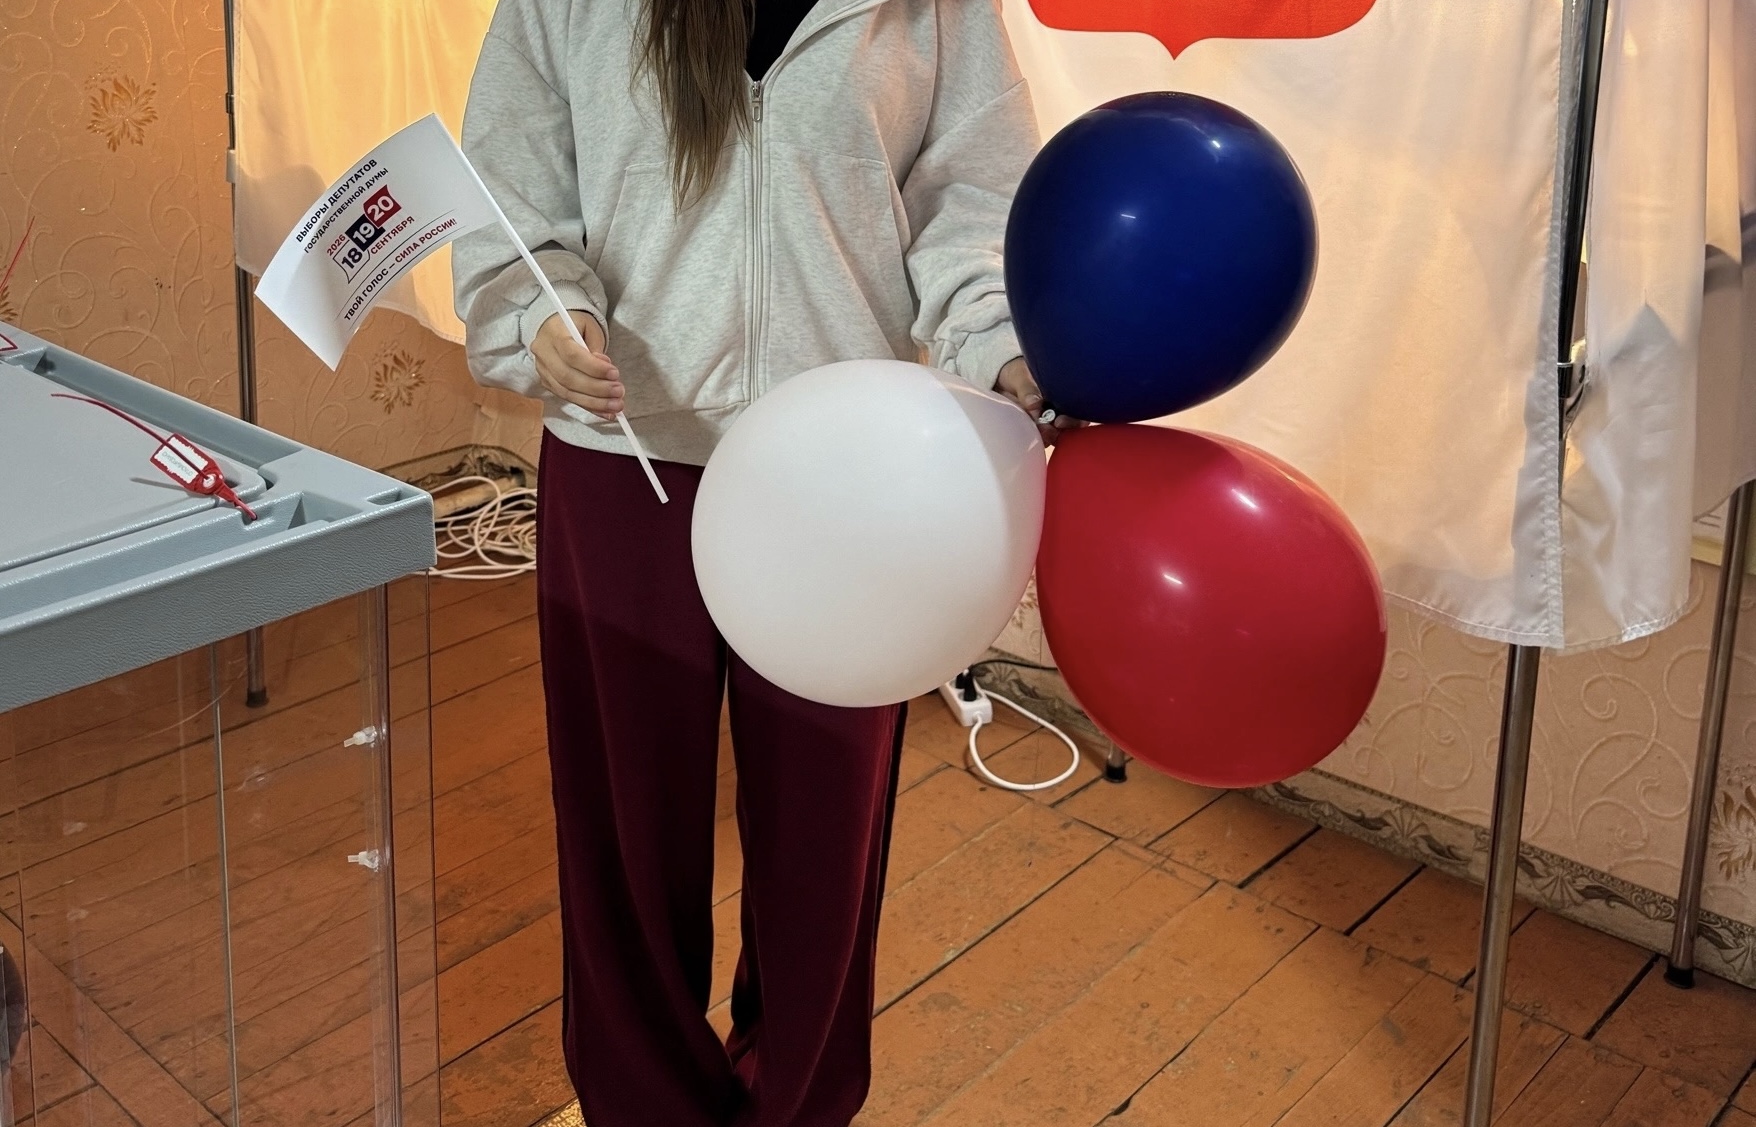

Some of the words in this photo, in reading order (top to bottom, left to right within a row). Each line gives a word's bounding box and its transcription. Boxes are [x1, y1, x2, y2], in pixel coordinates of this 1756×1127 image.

[295, 203, 330, 243] ВЫБОРЫ
[327, 159, 378, 207] ДЕПУТАТОВ
[303, 185, 367, 254] ГОСУДАРСТВЕННОЙ
[364, 167, 389, 190] ДУМЫ
[341, 247, 363, 270] 18
[352, 222, 376, 244] 19
[367, 195, 395, 222] 20
[370, 215, 416, 255] СЕНТЯБРЯ
[326, 233, 347, 257] 2026
[343, 295, 365, 322] ТВОЙ
[361, 268, 389, 298] ГОЛОС
[395, 242, 421, 263] СИЛА
